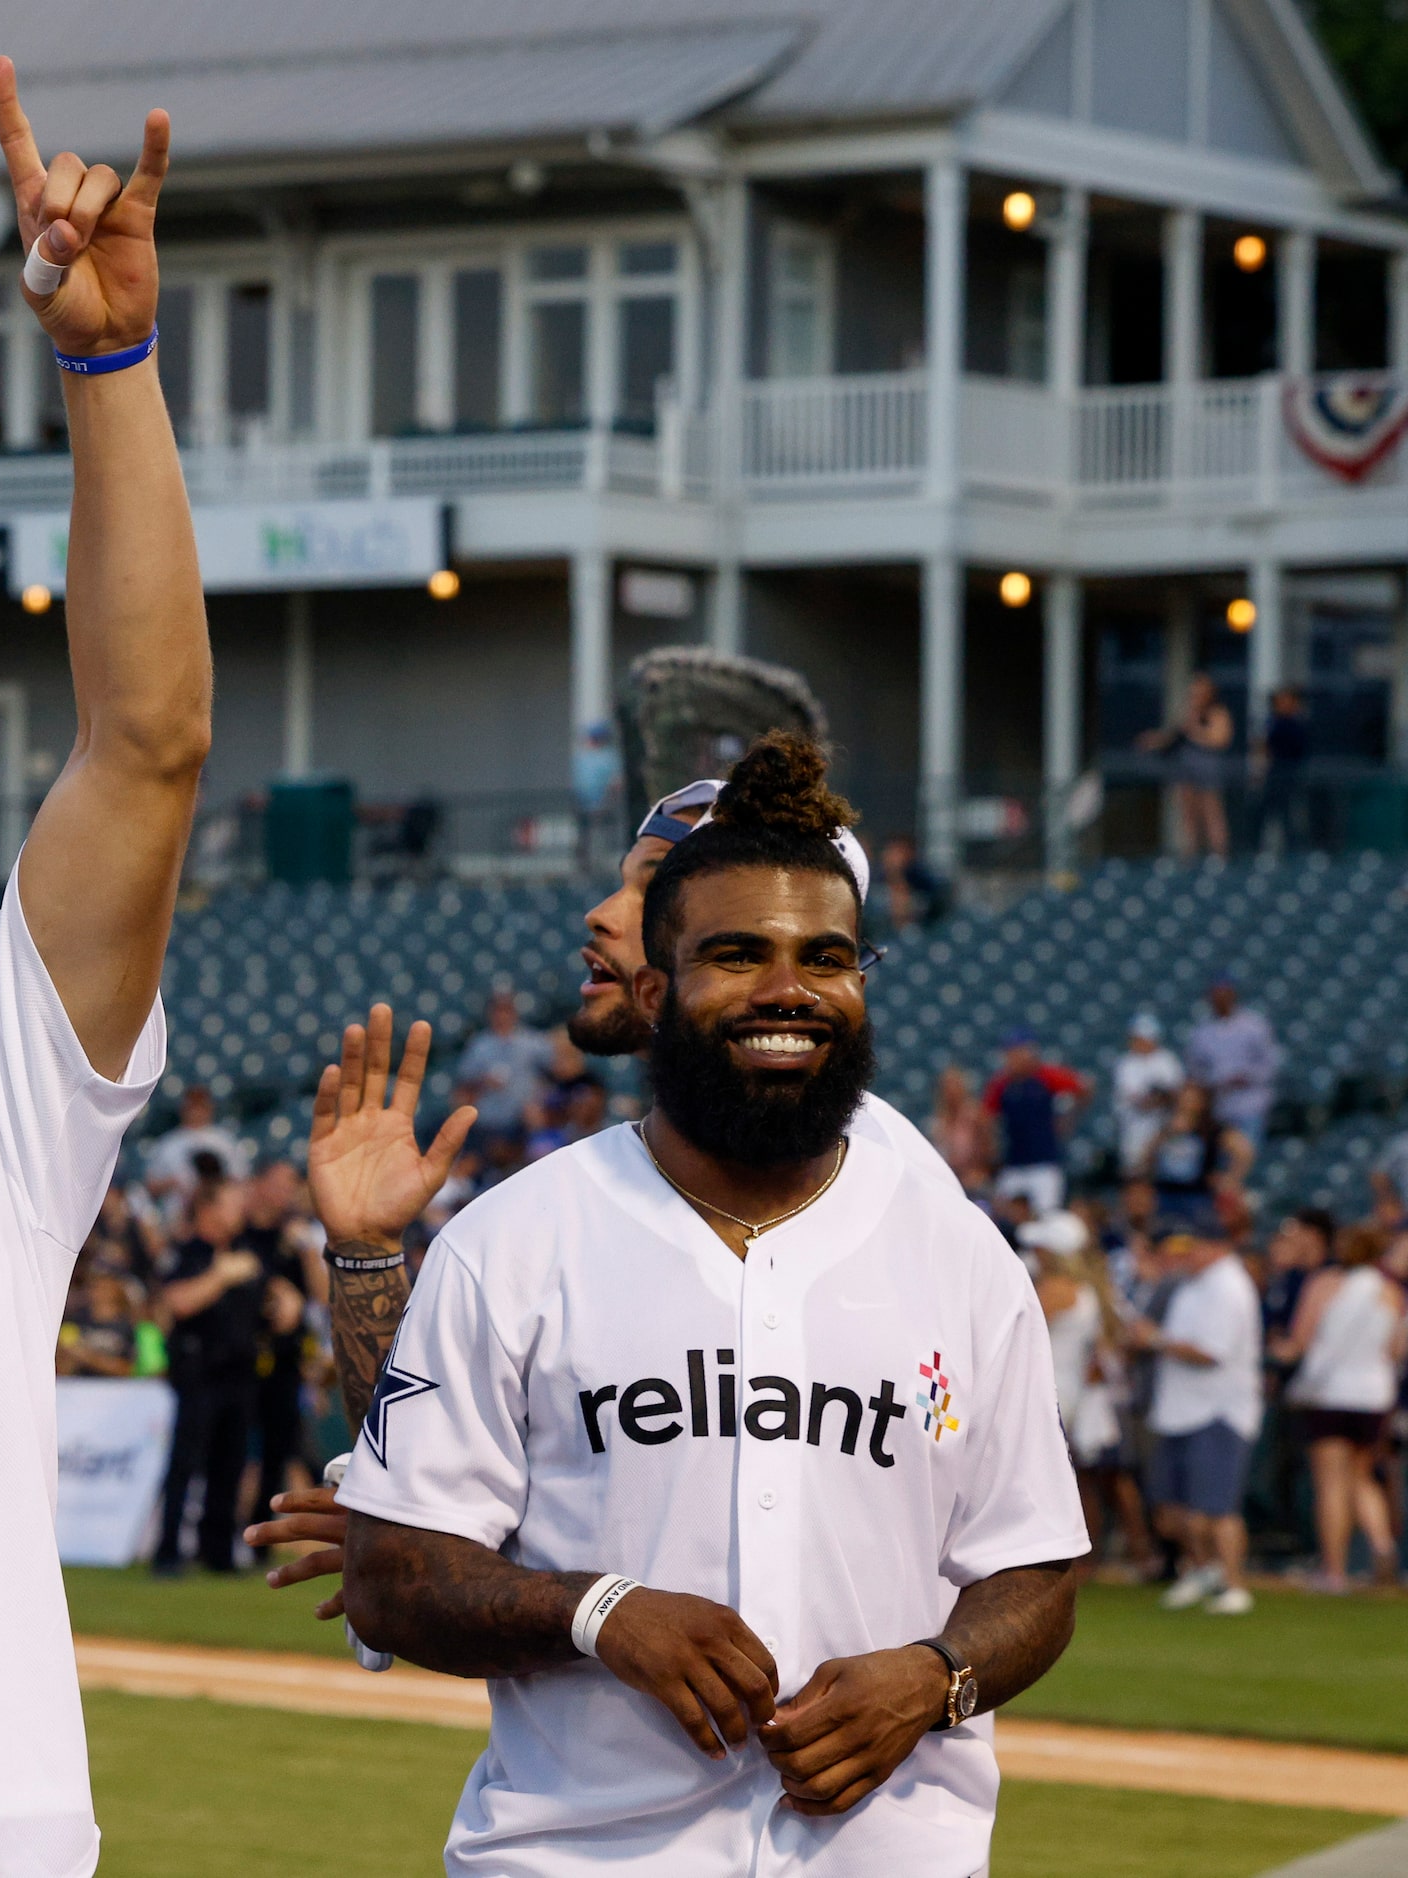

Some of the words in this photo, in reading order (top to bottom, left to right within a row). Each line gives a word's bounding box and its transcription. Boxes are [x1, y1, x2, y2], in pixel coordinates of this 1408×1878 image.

[55, 356, 71, 369] CO
[71, 362, 88, 372] LIL
[578, 1348, 907, 1468] reliant
[598, 1597, 615, 1616] WAY
